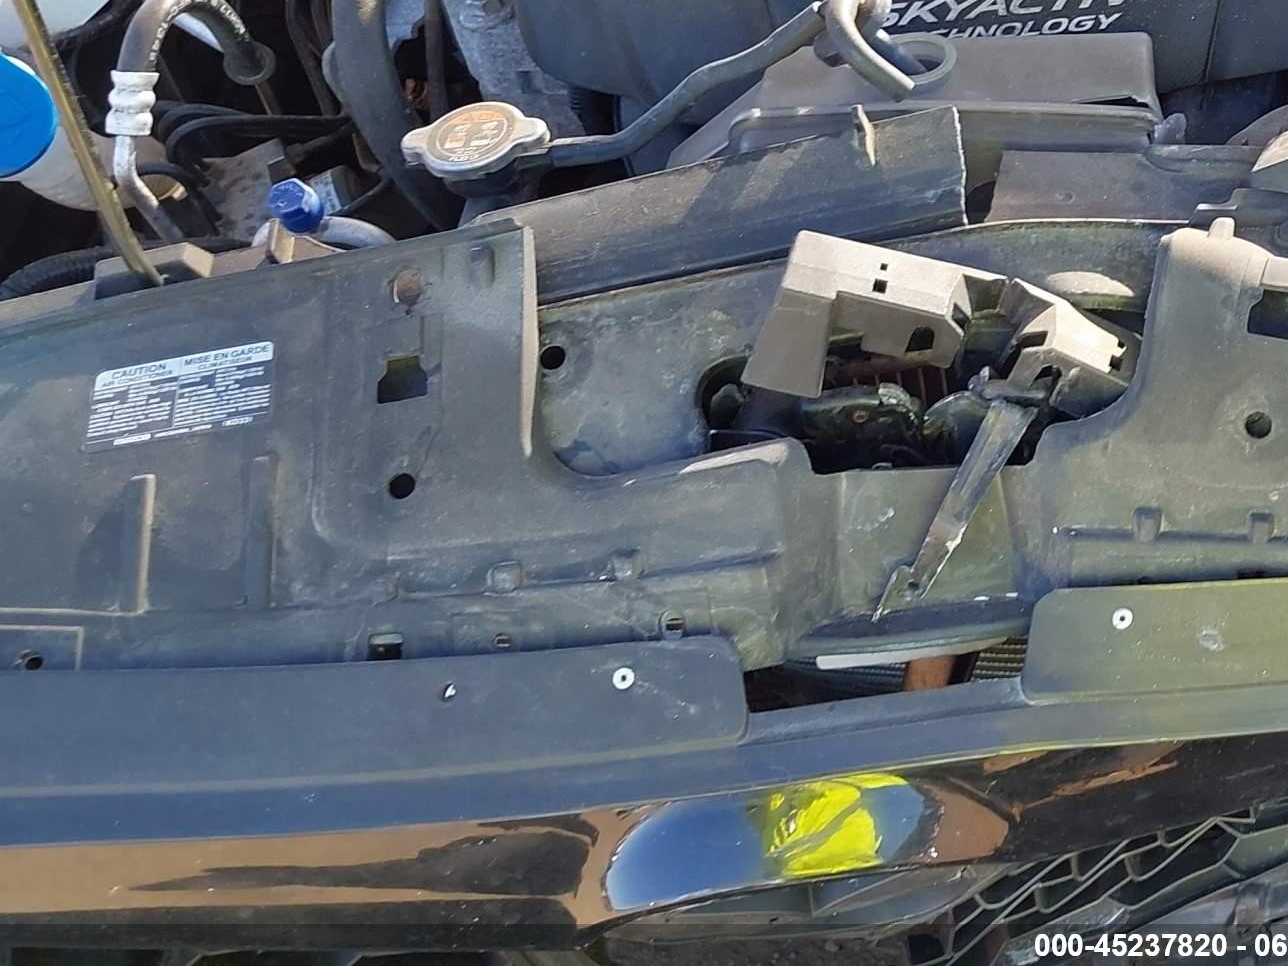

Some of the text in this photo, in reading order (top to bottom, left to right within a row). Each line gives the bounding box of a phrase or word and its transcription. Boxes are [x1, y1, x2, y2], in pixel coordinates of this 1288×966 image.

[928, 12, 1122, 39] HNOLOGY
[184, 344, 270, 366] MISE EN GARDE
[111, 363, 167, 380] CAUTION
